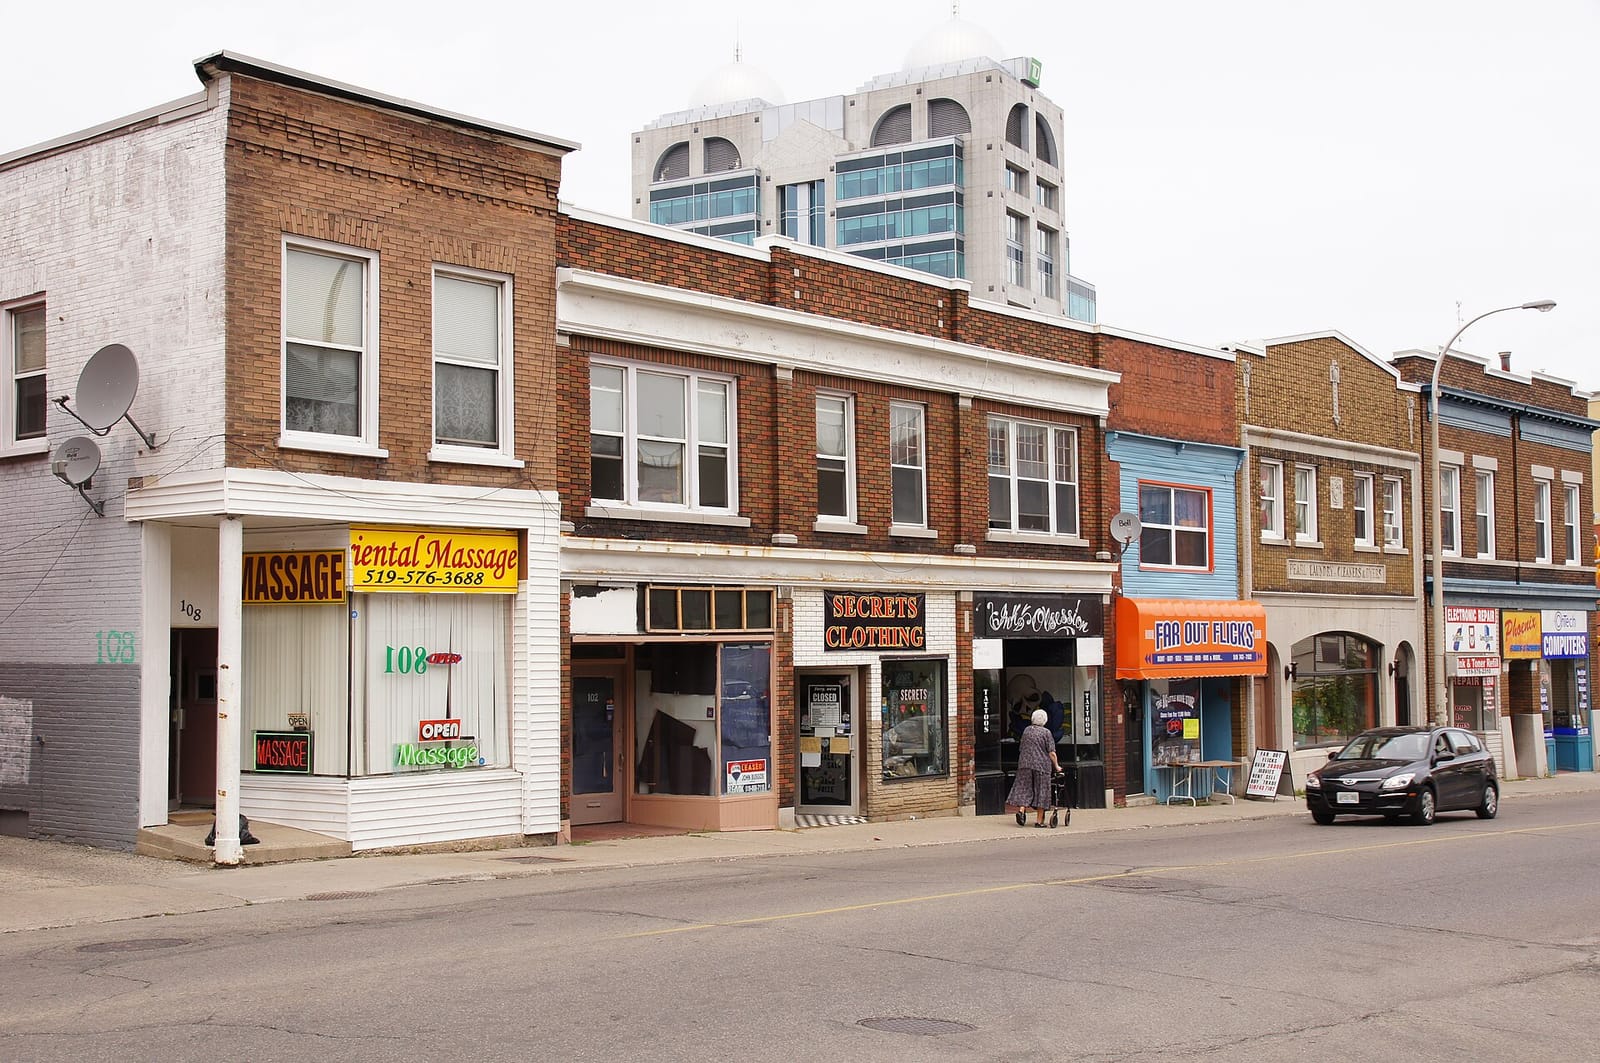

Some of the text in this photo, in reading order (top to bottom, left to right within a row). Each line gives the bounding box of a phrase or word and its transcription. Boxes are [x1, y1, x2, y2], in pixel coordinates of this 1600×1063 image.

[426, 539, 518, 580] Massage
[362, 569, 485, 585] 519-576-3688
[180, 600, 202, 621] 108
[833, 594, 918, 618] SECRETS
[1447, 608, 1495, 623] ELECTRONIC REPAIR
[825, 625, 924, 648] CLOTHING
[1154, 621, 1255, 652] FAR OUT FLICKS
[1504, 616, 1536, 642] Phoenix
[95, 629, 135, 664] 108
[1543, 635, 1586, 656] COMPUTERS
[384, 646, 427, 674] 108
[1458, 658, 1466, 668] Ink
[1472, 658, 1486, 668] Toner
[587, 692, 599, 702] 102
[812, 693, 837, 702] CLOSED
[900, 688, 928, 701] SECRETS
[288, 717, 308, 726] OPEN
[421, 723, 459, 739] OPEN
[256, 740, 307, 768] MASSAGE
[397, 743, 479, 769] Massage
[741, 763, 763, 771] LEASED
